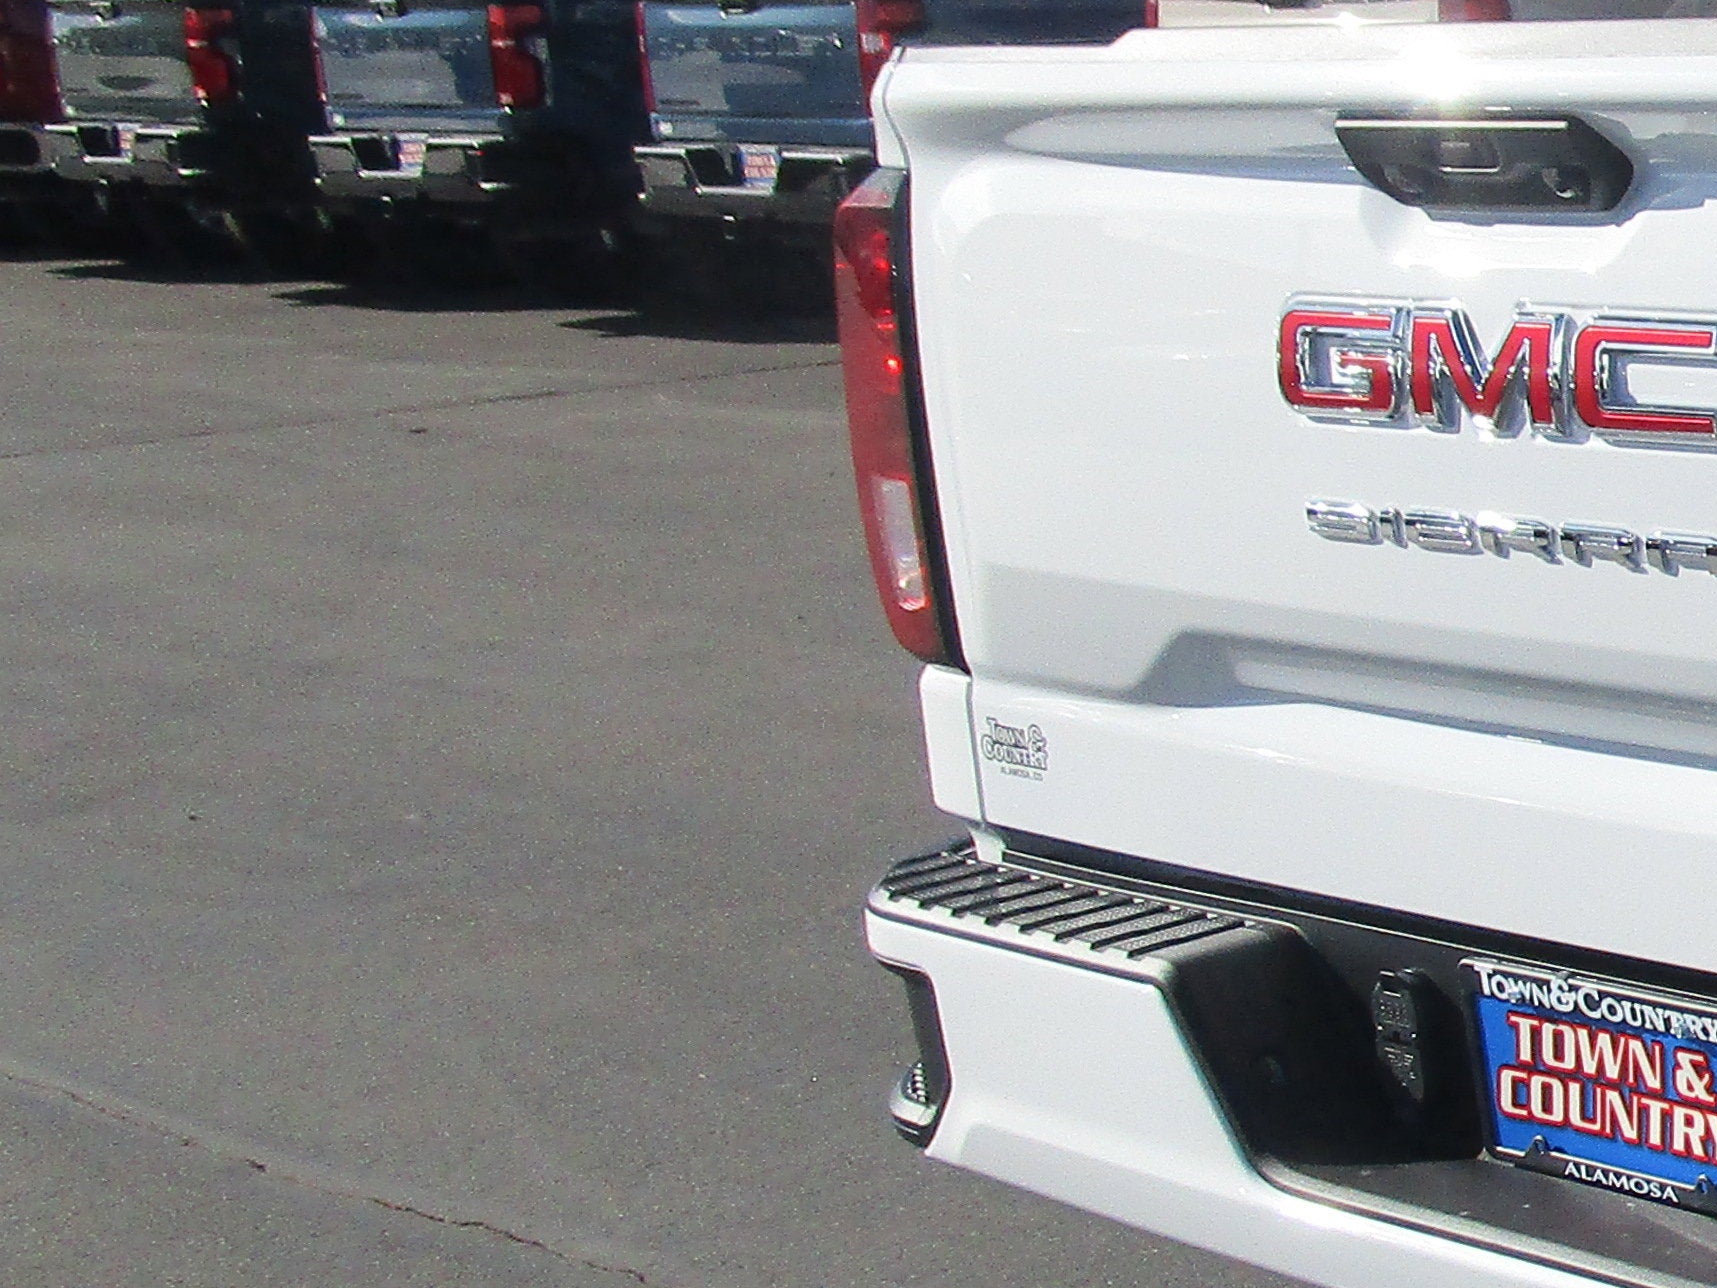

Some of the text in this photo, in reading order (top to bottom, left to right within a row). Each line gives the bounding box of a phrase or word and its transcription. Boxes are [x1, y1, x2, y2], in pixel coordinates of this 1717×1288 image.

[1507, 1011, 1717, 1106] TOWN &
[1564, 1161, 1679, 1203] ALAMOSA
